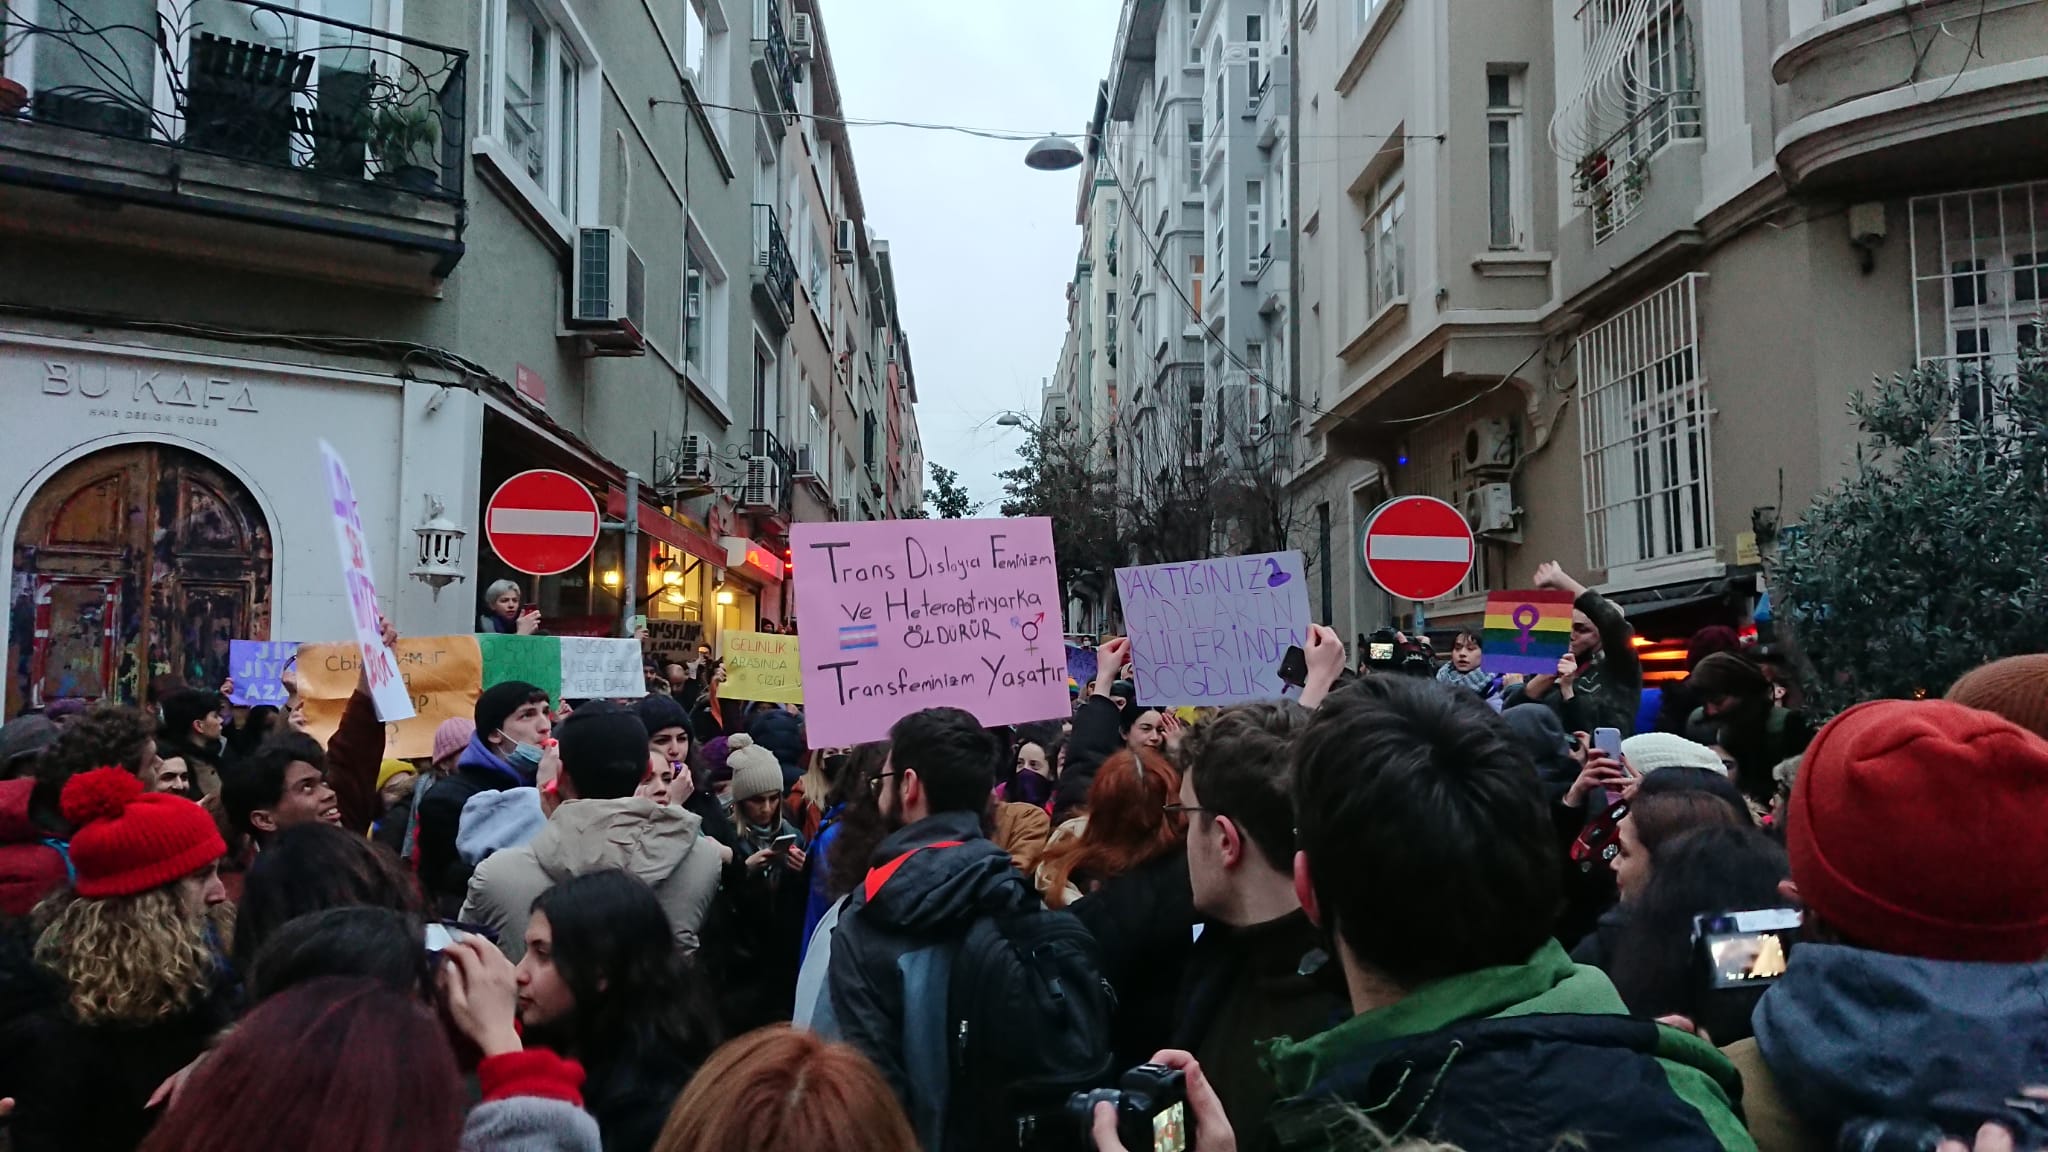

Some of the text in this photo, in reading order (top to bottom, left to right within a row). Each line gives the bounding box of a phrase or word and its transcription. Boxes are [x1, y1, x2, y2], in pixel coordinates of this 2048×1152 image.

[42, 360, 259, 413] BU KAFA
[89, 409, 217, 427] HAIR DESIGN HOUSE
[810, 542, 895, 583] Trans
[990, 534, 1051, 570] Feminizm
[981, 655, 1065, 696] Yaşatır
[1136, 664, 1270, 700] DOĞDUK
